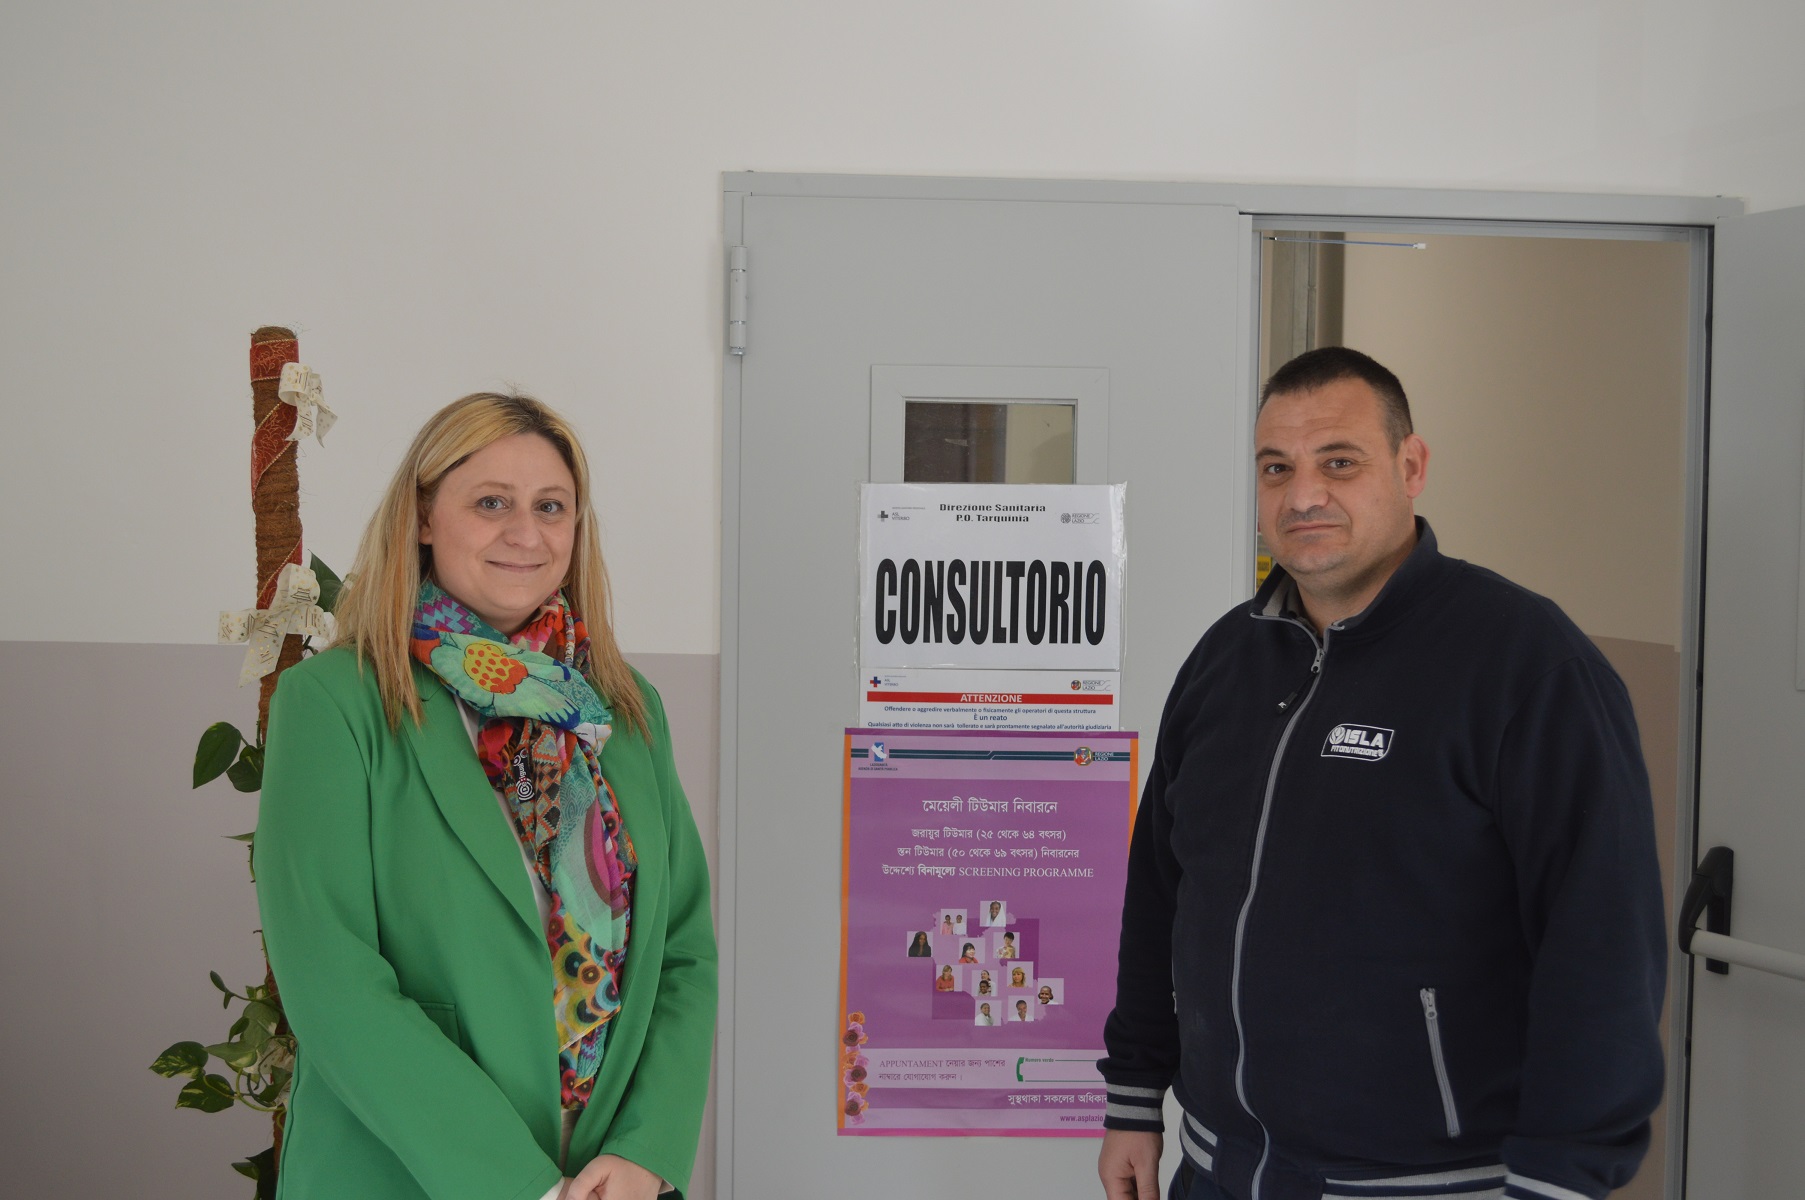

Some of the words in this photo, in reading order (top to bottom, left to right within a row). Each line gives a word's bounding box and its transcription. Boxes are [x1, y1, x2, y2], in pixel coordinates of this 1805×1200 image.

[940, 504, 992, 512] Direzione
[995, 504, 1046, 512] Sanitaria
[976, 514, 1029, 522] Tarquinia
[875, 558, 1106, 646] CONSULTORIO
[960, 693, 1022, 703] ATTENZIONE
[1344, 729, 1383, 748] ISLA
[968, 797, 1008, 813] টিউমার
[1012, 797, 1058, 814] নিবারনে
[943, 826, 973, 838] টিউমার
[997, 829, 1019, 839] থেকে
[1022, 830, 1035, 839] ৬৪
[914, 845, 944, 857] টিউমার
[969, 848, 991, 857] থেকে
[1041, 846, 1079, 858] নিবারনের
[959, 867, 1020, 877] SCREENING
[1023, 868, 1094, 878] PROGRAMME
[1044, 1094, 1074, 1103] সকলের
